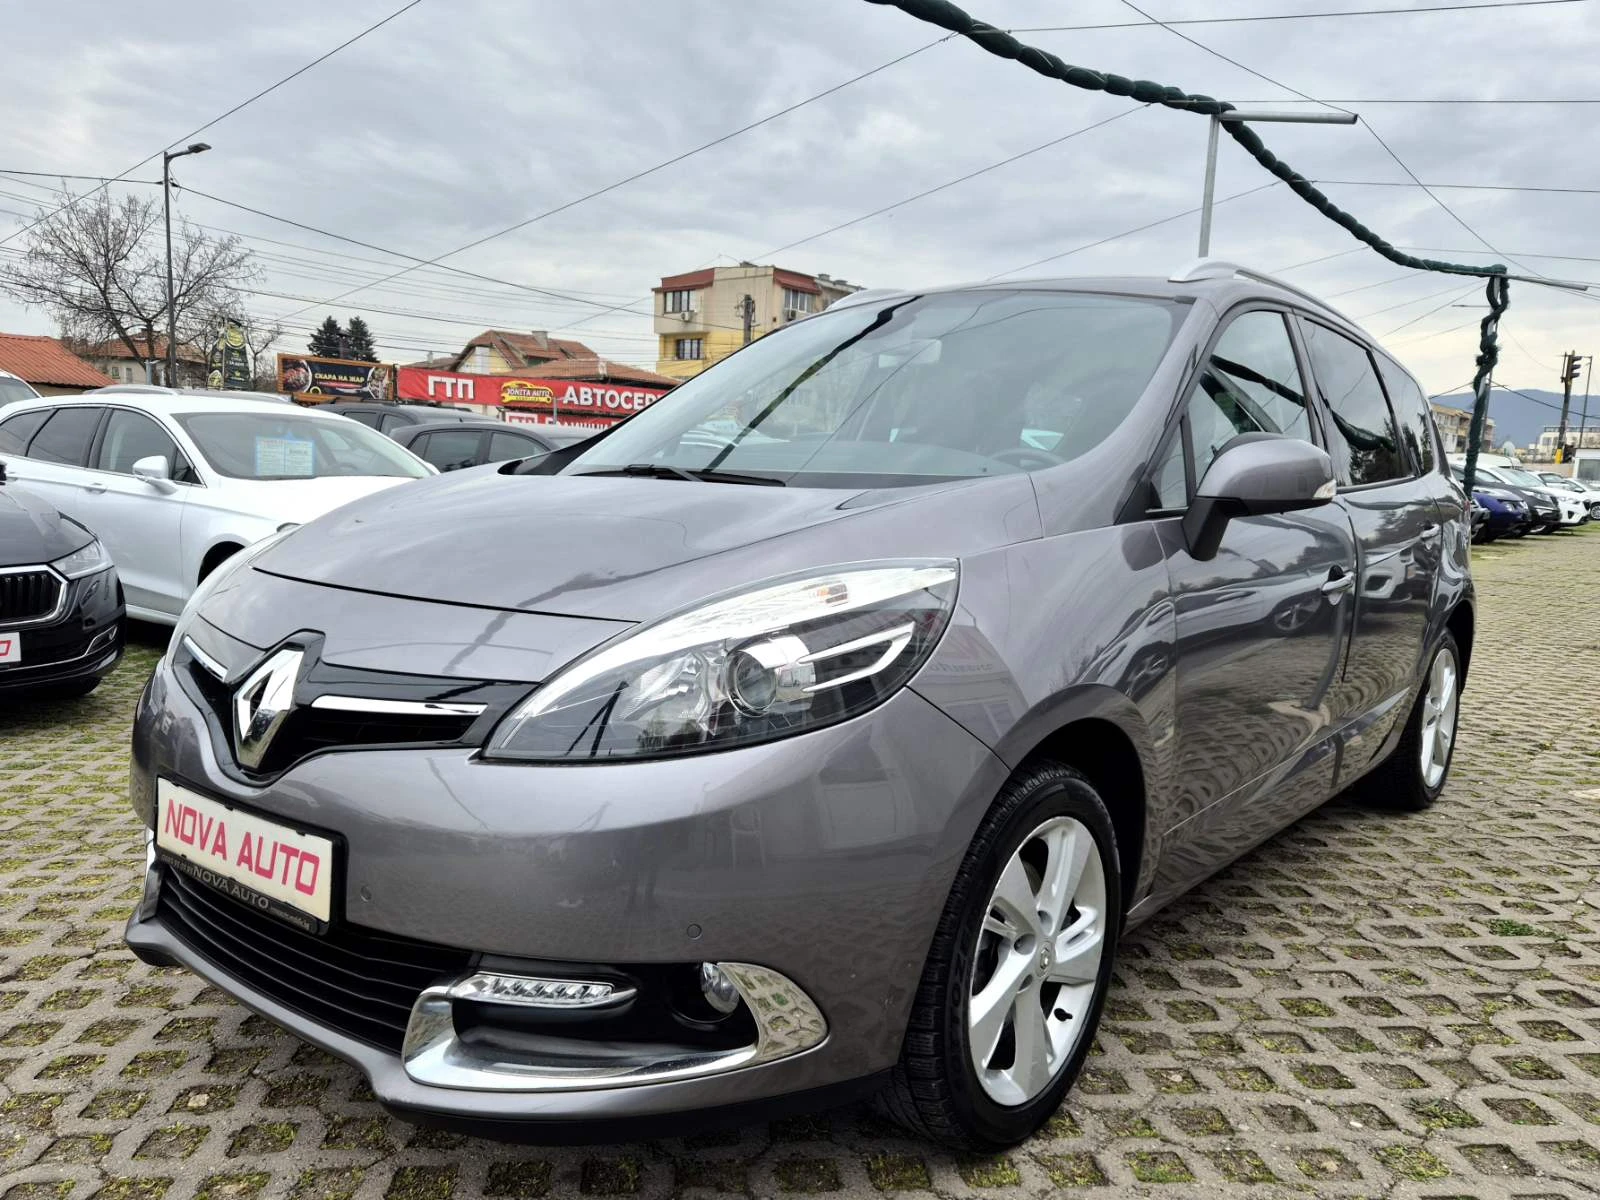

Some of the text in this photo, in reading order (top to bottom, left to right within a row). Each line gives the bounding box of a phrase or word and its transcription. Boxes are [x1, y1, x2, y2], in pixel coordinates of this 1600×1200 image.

[314, 372, 337, 380] СКАРА
[428, 375, 474, 399] ГТП
[531, 389, 550, 398] AUTO
[562, 385, 663, 410] АВТОСЕР
[165, 799, 320, 896] NOVA AUTO
[193, 866, 269, 909] NOVA AUTO
